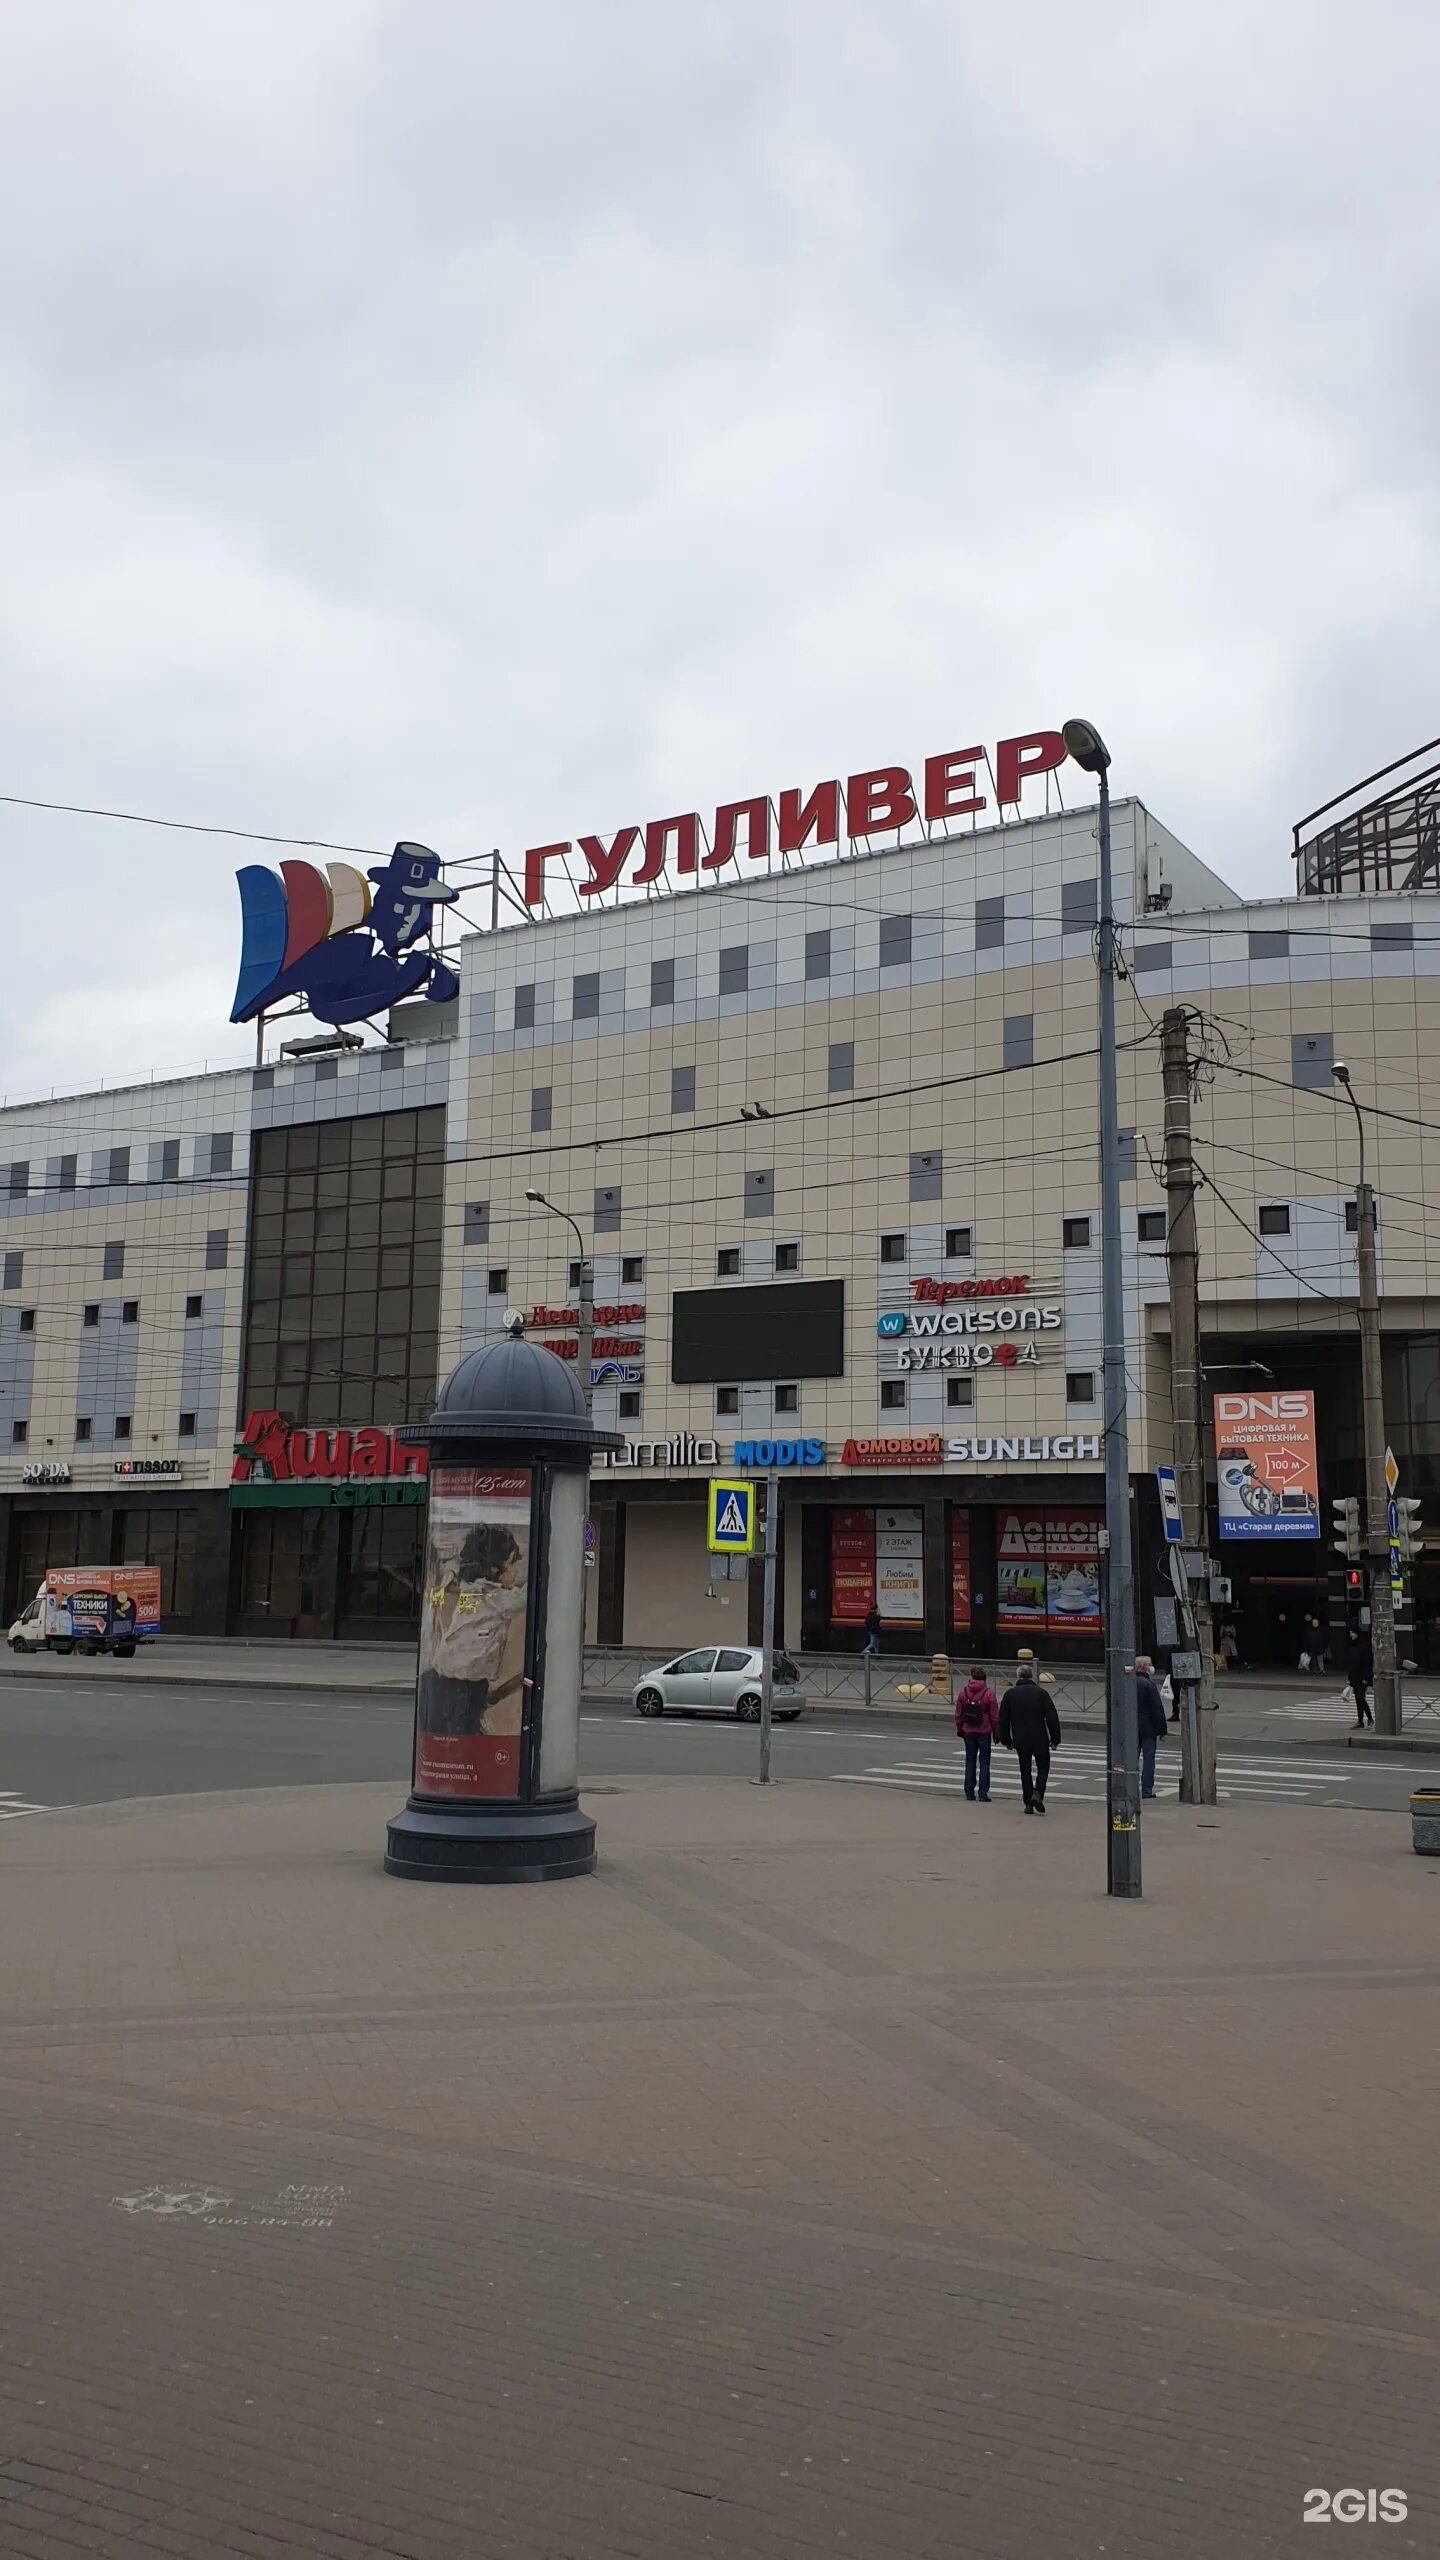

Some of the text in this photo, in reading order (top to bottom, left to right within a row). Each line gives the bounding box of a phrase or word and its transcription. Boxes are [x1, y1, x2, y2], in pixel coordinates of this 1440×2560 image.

[524, 730, 1068, 906] ГУЛЛИВЕР
[910, 1274, 1030, 1306] Теремок
[911, 1305, 1062, 1336] watsons
[1219, 1395, 1309, 1420] DNS
[1233, 1424, 1286, 1434] ЦИФРОВАЯ
[1220, 1434, 1309, 1443] БЫТОВАЯ ТЕХНИКА
[231, 1410, 428, 1481] Ашан
[947, 1436, 1099, 1461] SUNLIGH
[733, 1438, 826, 1467] MODIS
[132, 1460, 179, 1473] TISSOT
[1271, 1460, 1288, 1469] 100
[1224, 1522, 1315, 1532] ТЦ «Старая деревня»
[48, 1573, 76, 1585] DNS
[114, 1572, 134, 1581] DNS
[886, 1569, 914, 1578] Любим
[885, 1581, 914, 1589] КНИГИ
[73, 1600, 108, 1611] ТЕХНИКИ
[138, 1605, 153, 1617] 500
[496, 1752, 508, 1761] 0+
